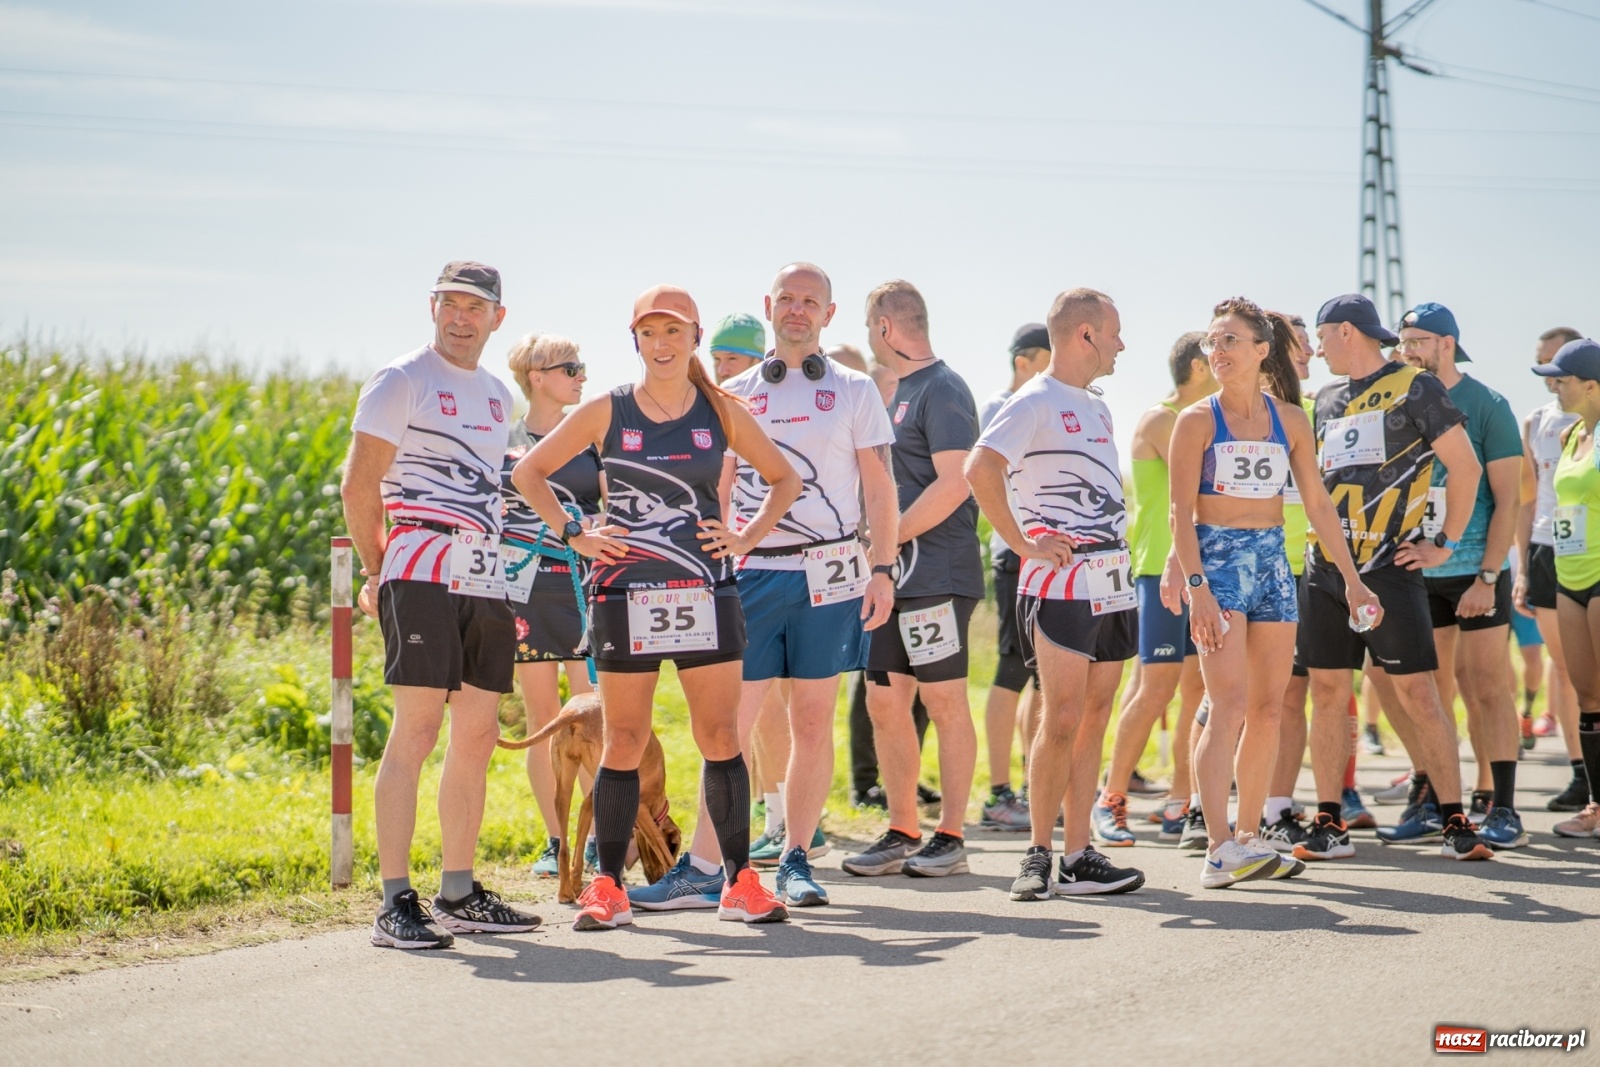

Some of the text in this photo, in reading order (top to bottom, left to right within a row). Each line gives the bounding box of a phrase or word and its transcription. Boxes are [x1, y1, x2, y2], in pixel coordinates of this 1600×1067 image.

[1344, 428, 1359, 449] 9
[1220, 444, 1281, 455] COLOUR RUN
[1233, 456, 1273, 480] 36
[1341, 517, 1358, 528] EG
[1344, 529, 1387, 541] RKOWY
[810, 545, 852, 560] COLOUR
[468, 549, 498, 576] 37
[825, 555, 860, 585] 21
[634, 592, 707, 606] COLOUR RUN
[650, 606, 696, 632] 35
[931, 607, 949, 619] RUN
[909, 622, 944, 648] 52
